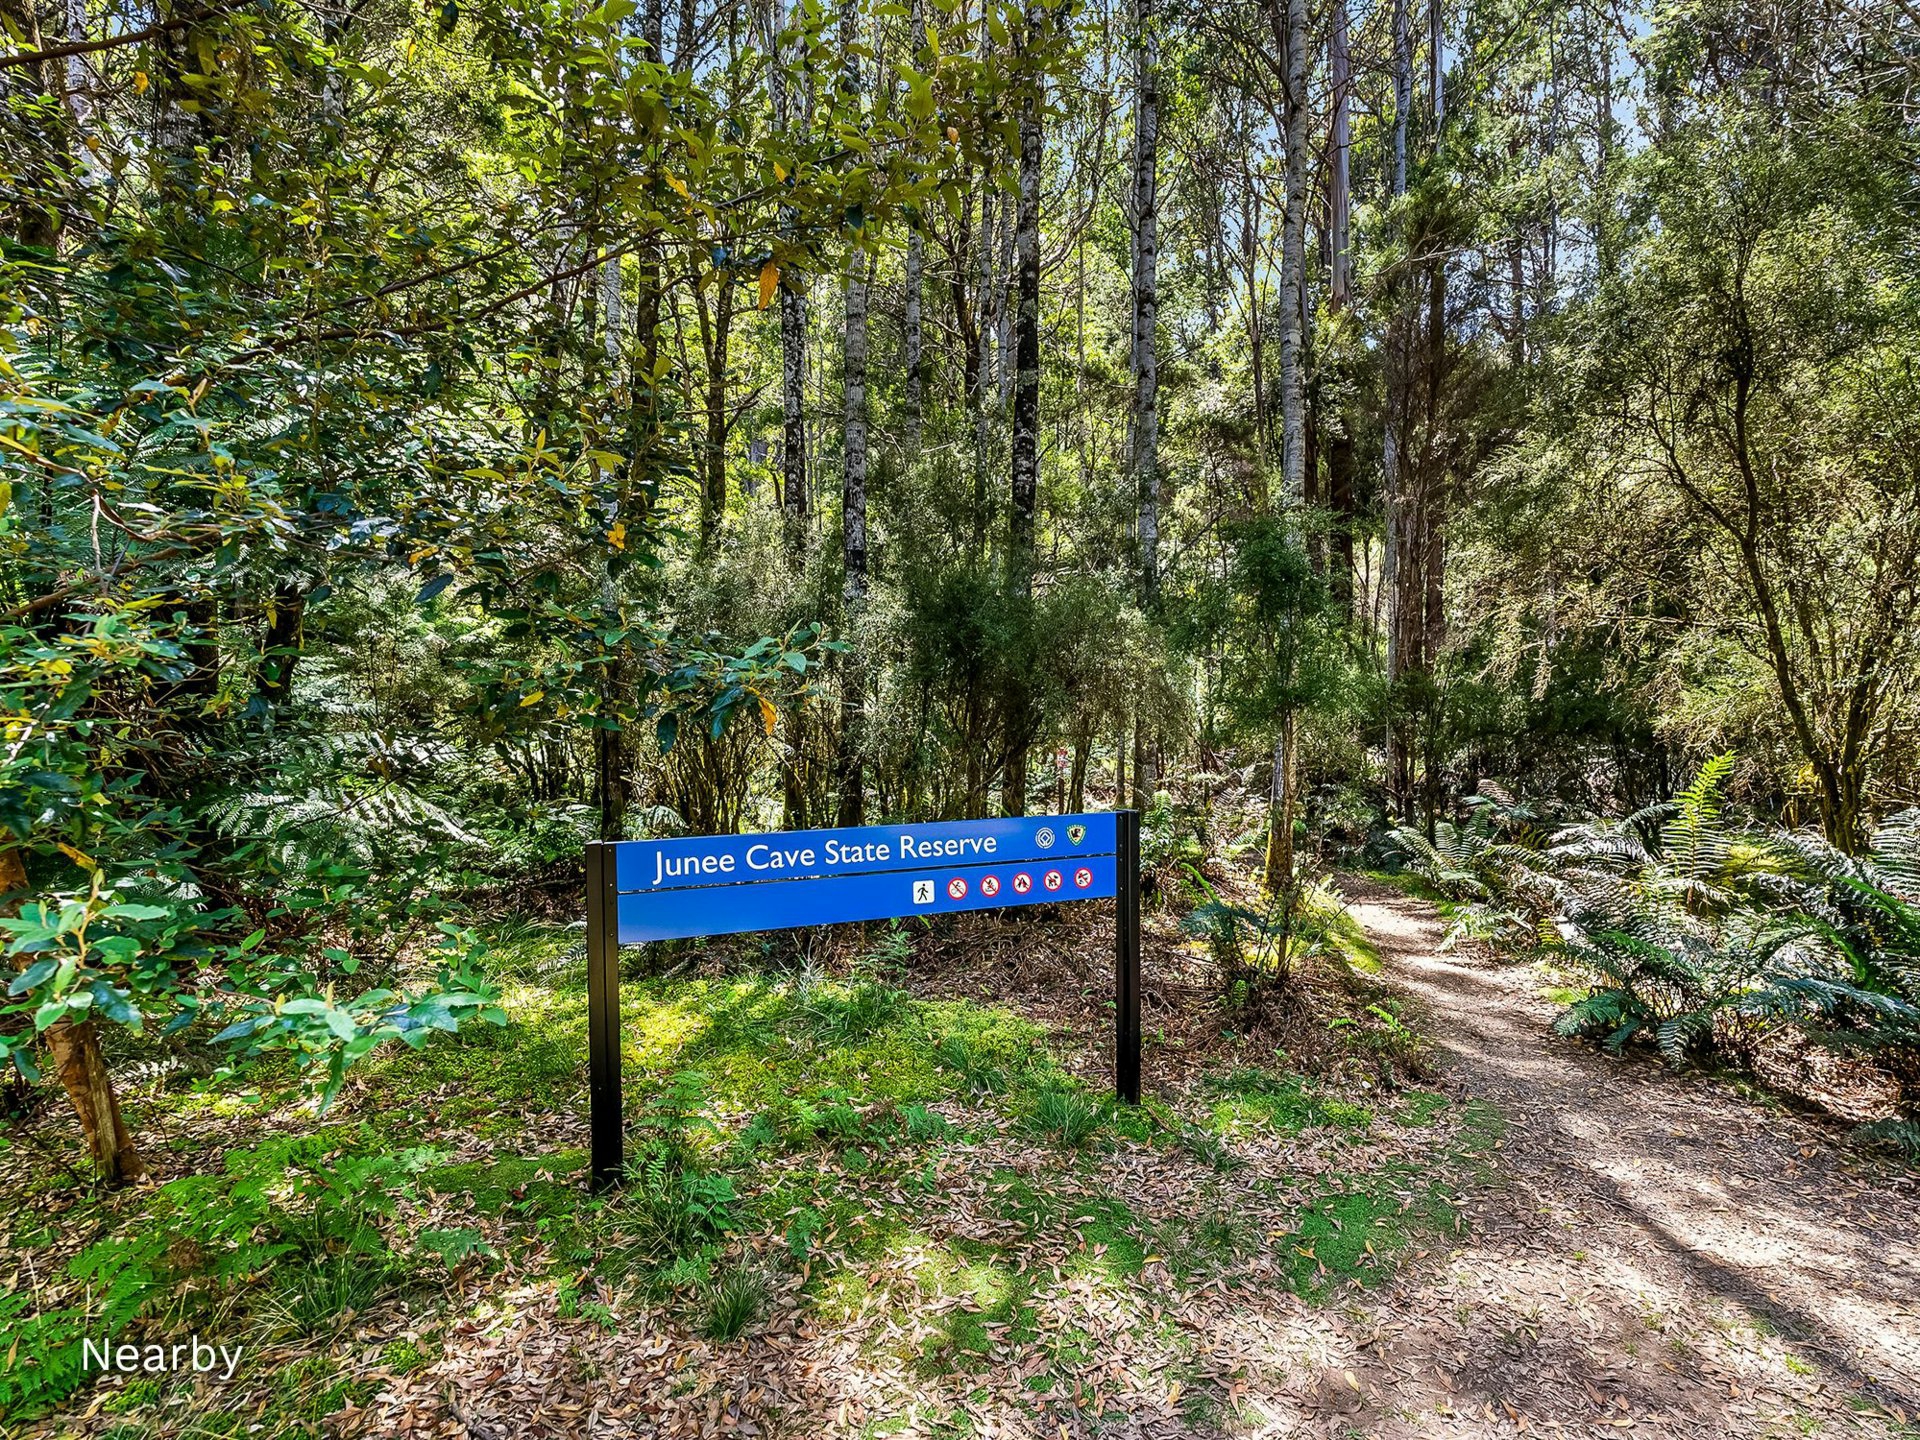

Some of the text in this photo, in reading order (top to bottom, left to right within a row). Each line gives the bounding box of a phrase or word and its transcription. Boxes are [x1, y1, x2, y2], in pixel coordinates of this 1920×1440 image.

[652, 834, 997, 886] Junee Cave State Reserve
